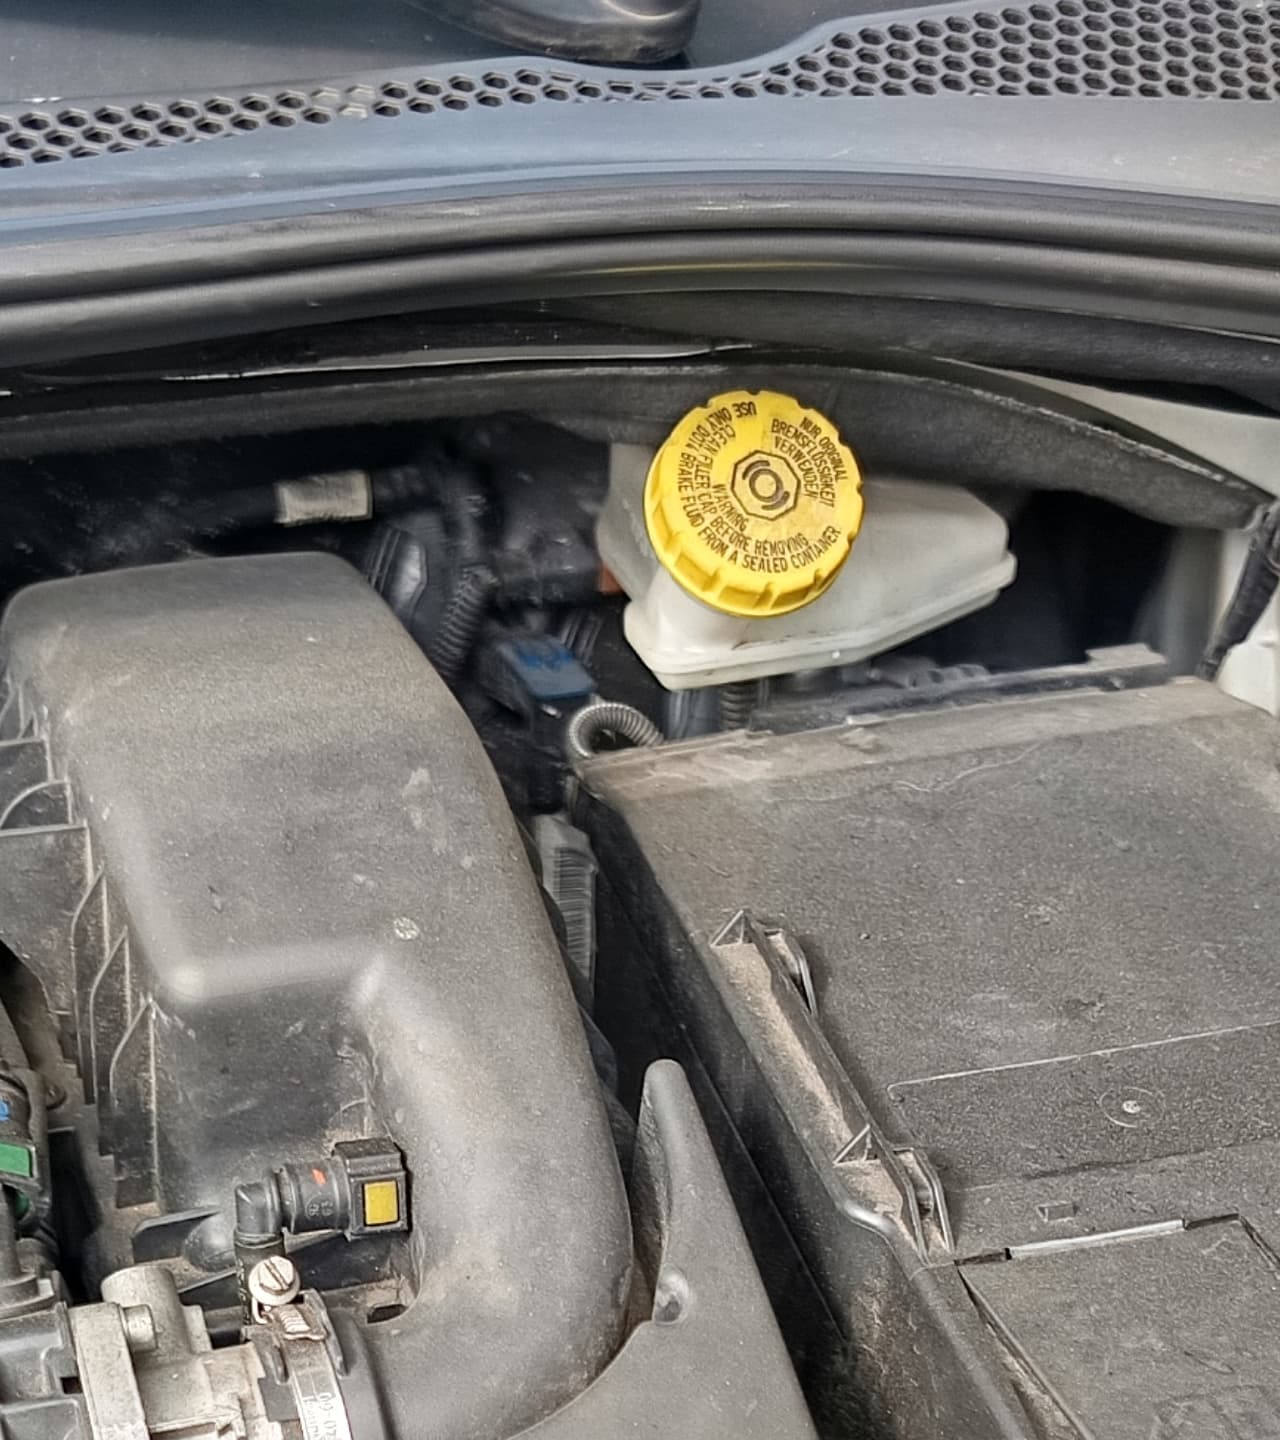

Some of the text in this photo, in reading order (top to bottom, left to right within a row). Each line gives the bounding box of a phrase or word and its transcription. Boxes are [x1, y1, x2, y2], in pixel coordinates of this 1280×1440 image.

[706, 407, 732, 432] ONLY
[732, 401, 757, 418] USE
[774, 435, 819, 499] VERWENDEN
[800, 416, 848, 482] NUR ORIGINAL
[677, 452, 697, 493] BRAKE
[694, 424, 809, 557] CLEAN FILLER CAP BEFORE REMOVING
[680, 496, 705, 528] FLUID
[712, 483, 749, 532] WARNING
[698, 526, 729, 557] FROM
[728, 550, 739, 565] A
[790, 525, 841, 568] CONTAINER
[741, 554, 788, 573] SEALED
